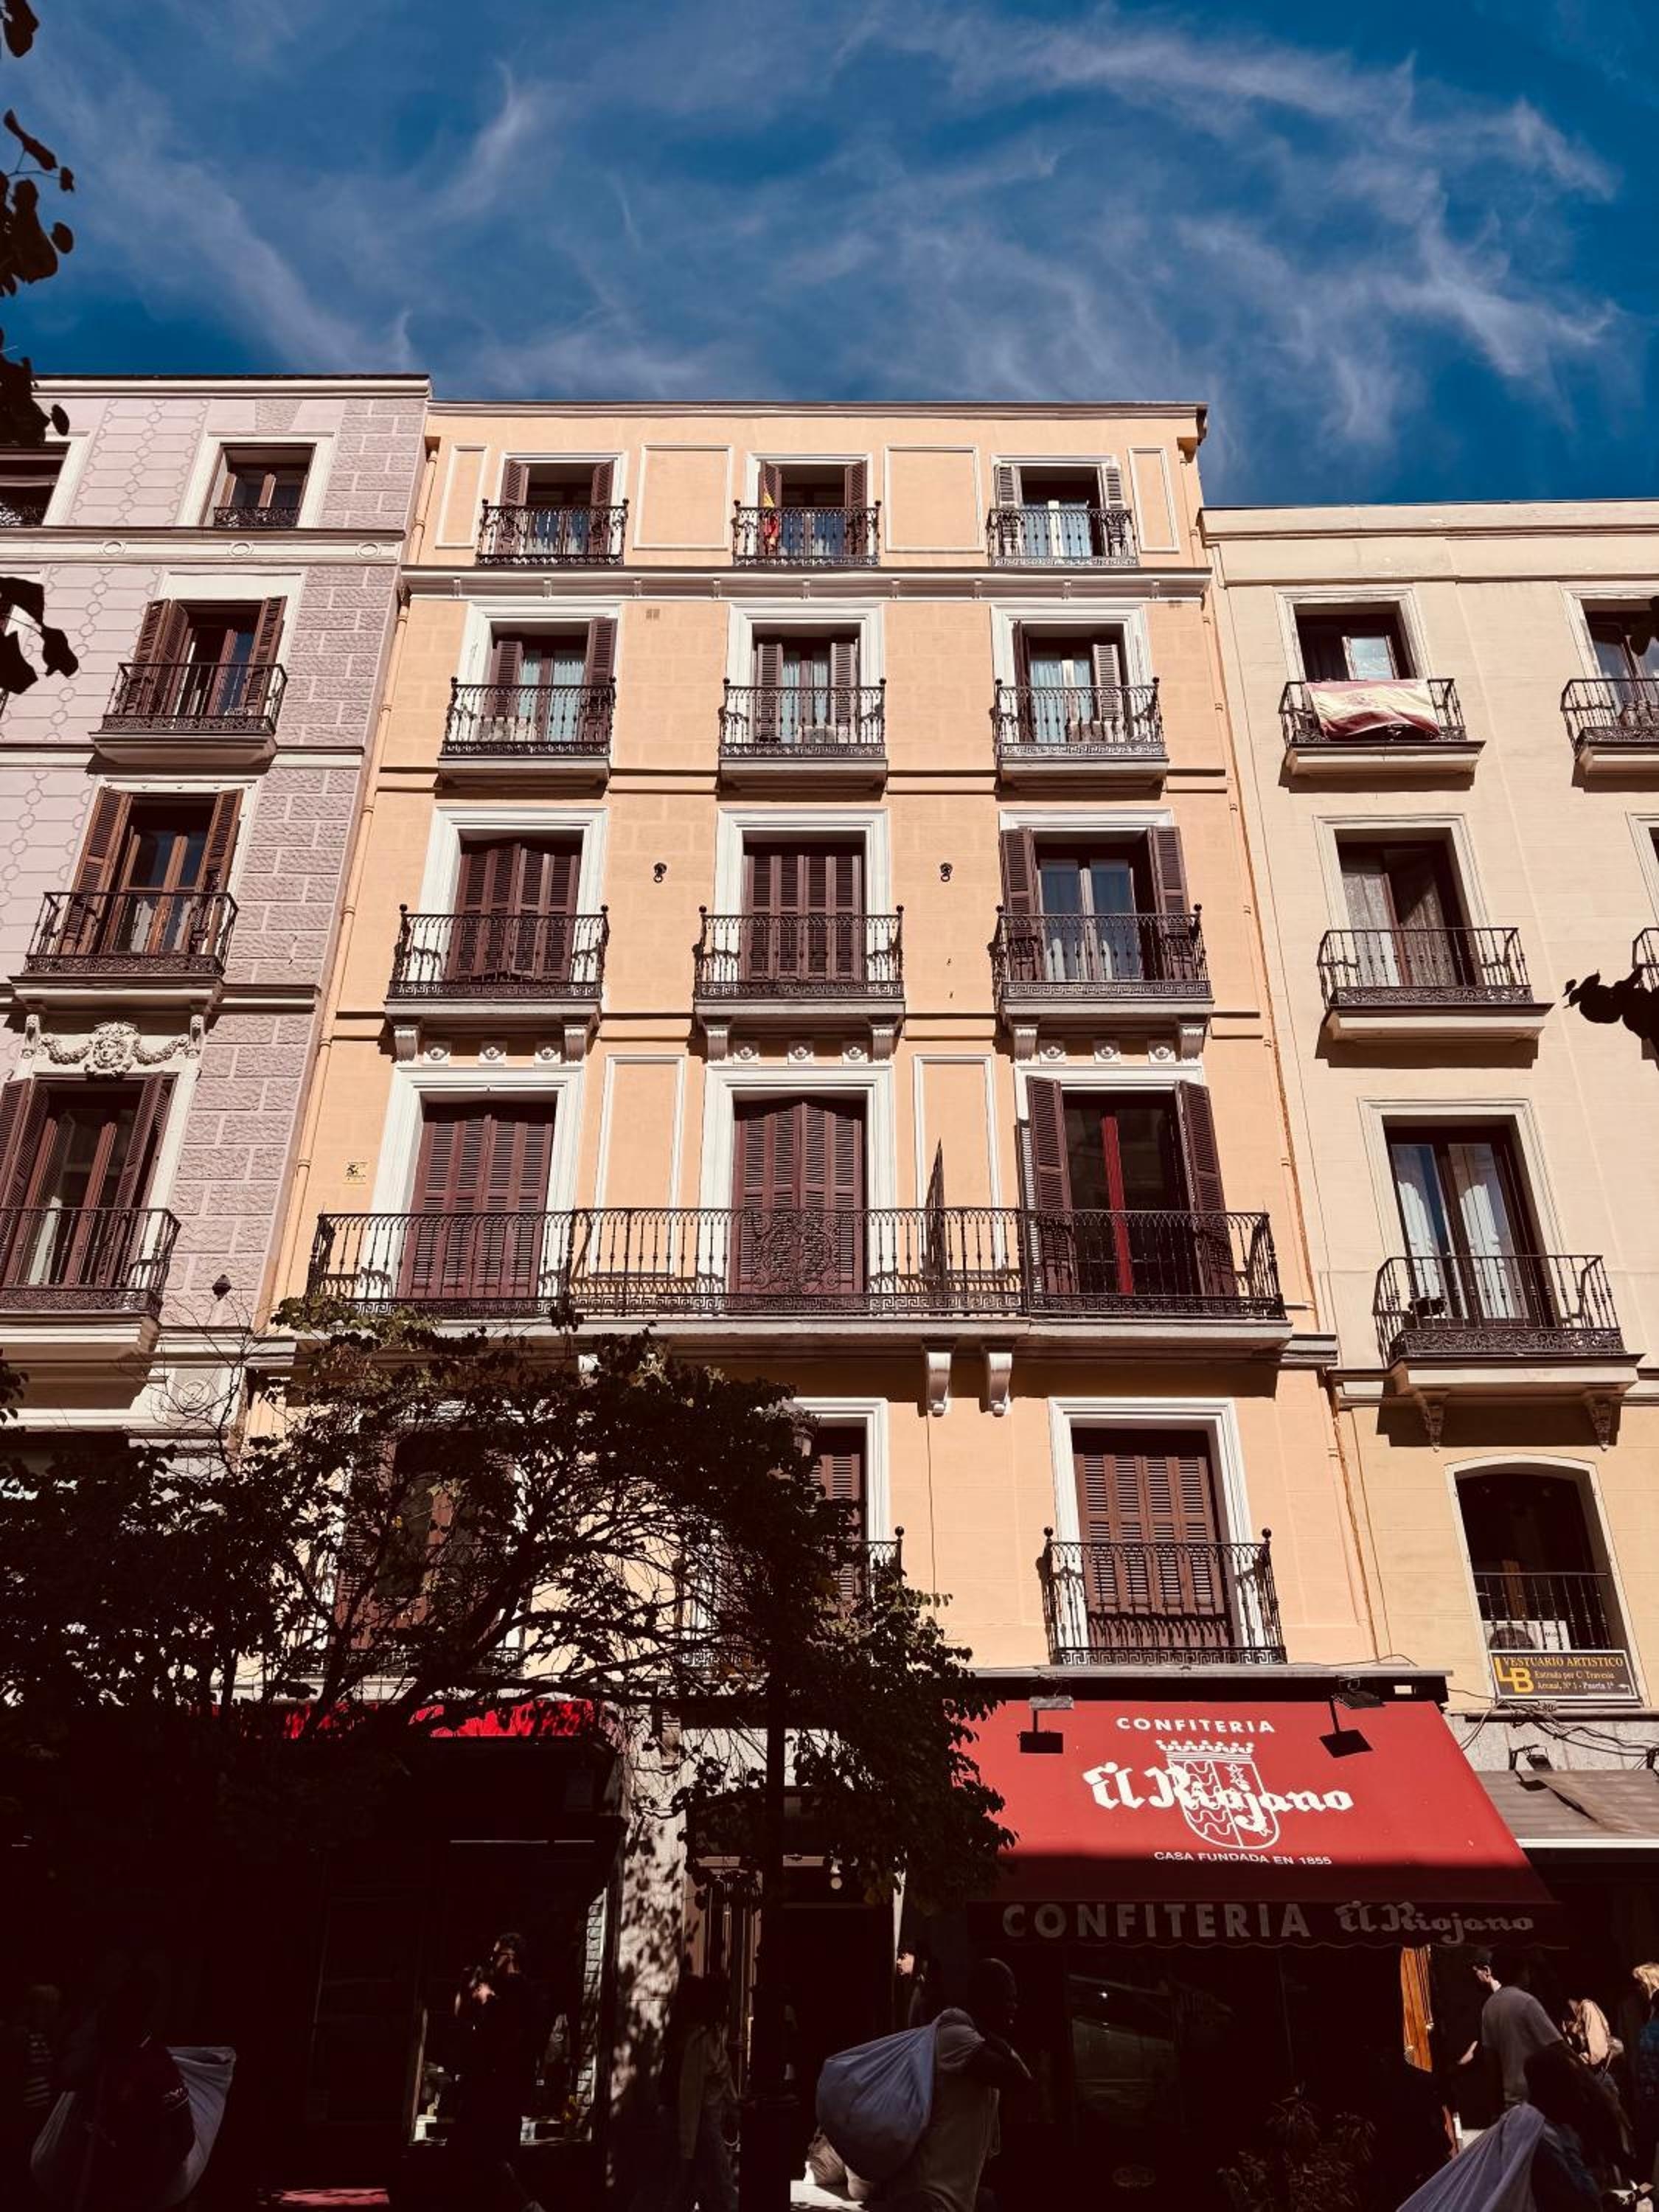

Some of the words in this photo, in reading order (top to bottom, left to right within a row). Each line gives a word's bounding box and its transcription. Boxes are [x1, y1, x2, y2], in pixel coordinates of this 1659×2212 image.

[1503, 1657, 1564, 1668] VESTUARIO
[1567, 1657, 1624, 1668] ARTISTICO
[1116, 1717, 1275, 1733] CONFITERIA
[1082, 1761, 1145, 1809] El
[1144, 1764, 1354, 1832] Riojano
[1154, 1851, 1194, 1861] CASA
[1197, 1853, 1269, 1863] FUNDADA
[1273, 1856, 1294, 1865] EN
[1298, 1857, 1332, 1865] 1855
[1002, 1902, 1311, 1938] CONFITERIA
[1334, 1900, 1379, 1933] El
[1379, 1902, 1534, 1945] Riojano
